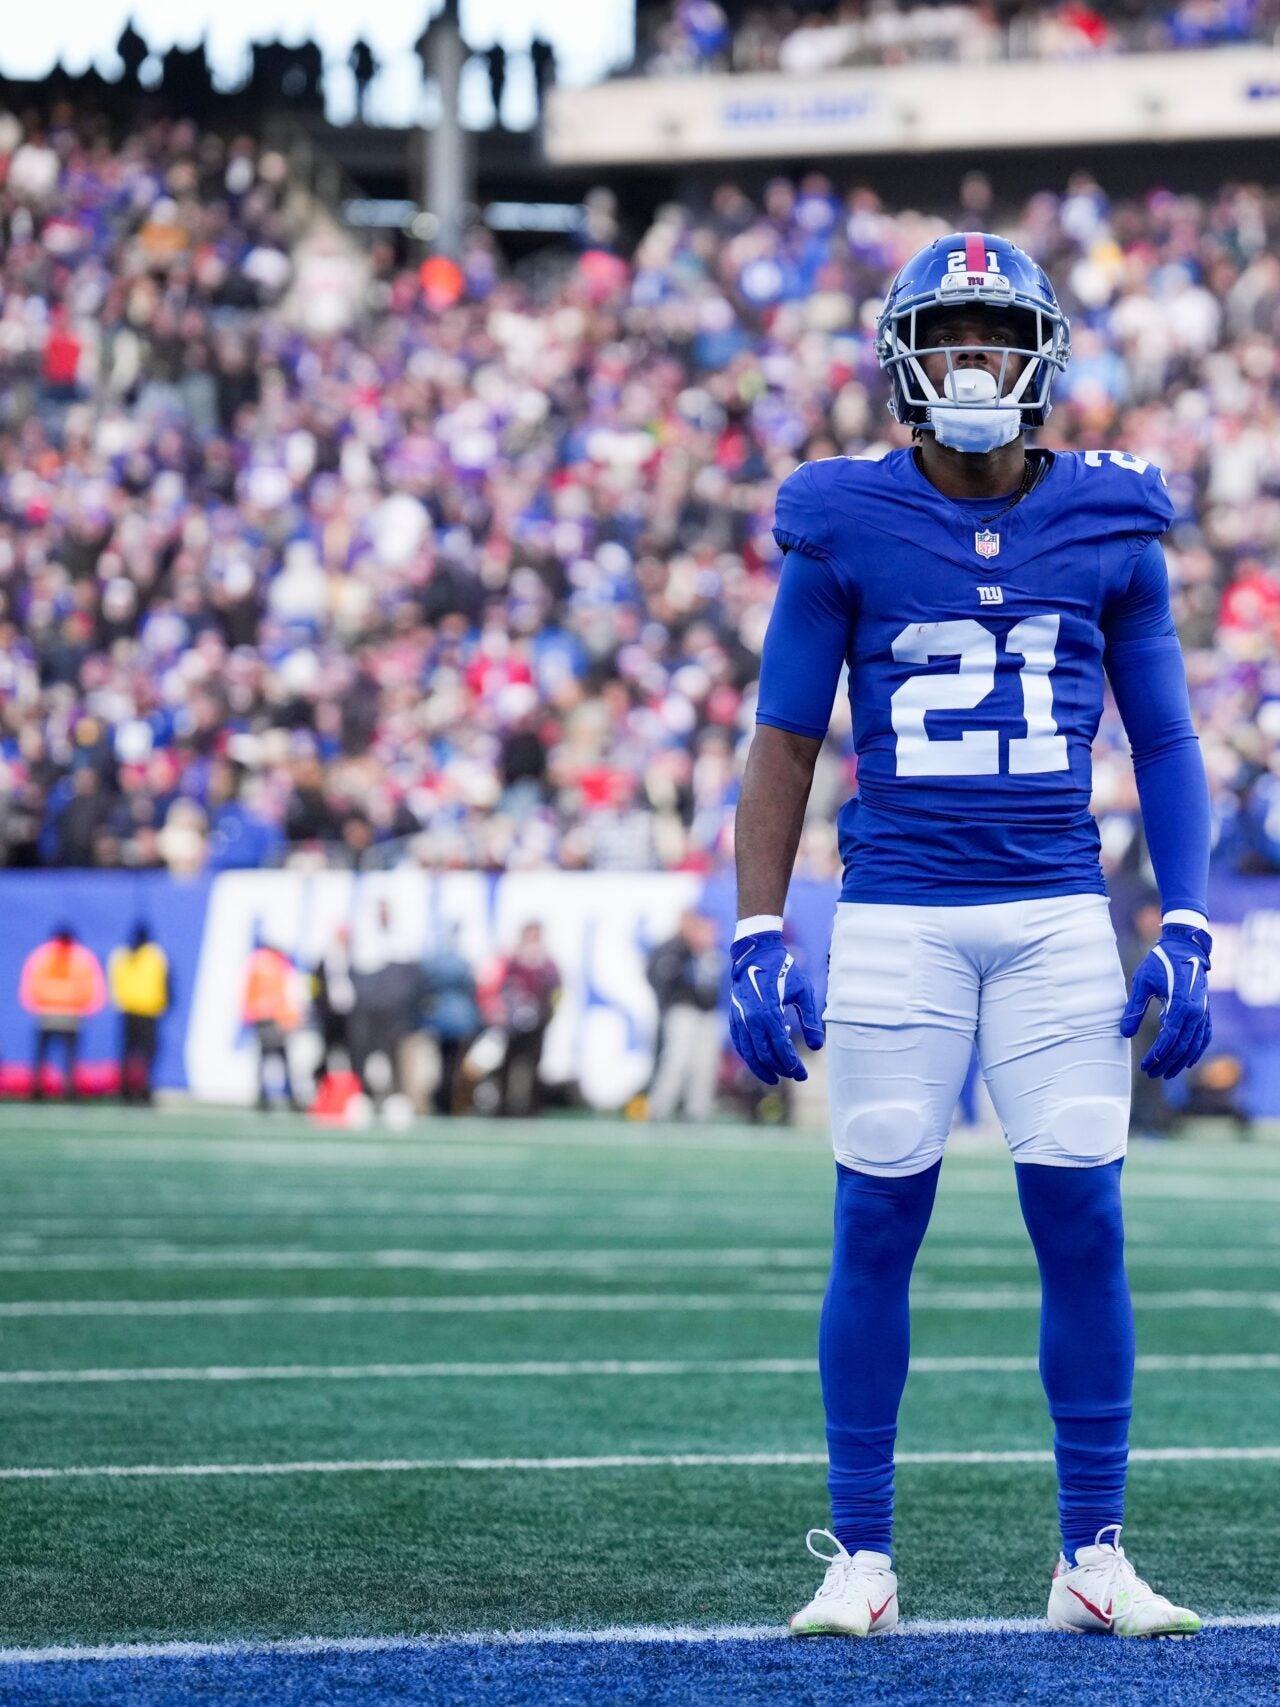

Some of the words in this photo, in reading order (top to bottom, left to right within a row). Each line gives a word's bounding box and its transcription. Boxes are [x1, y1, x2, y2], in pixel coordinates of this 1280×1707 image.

[947, 250, 1001, 273] 21
[978, 541, 997, 554] NFL
[890, 614, 1070, 777] 21
